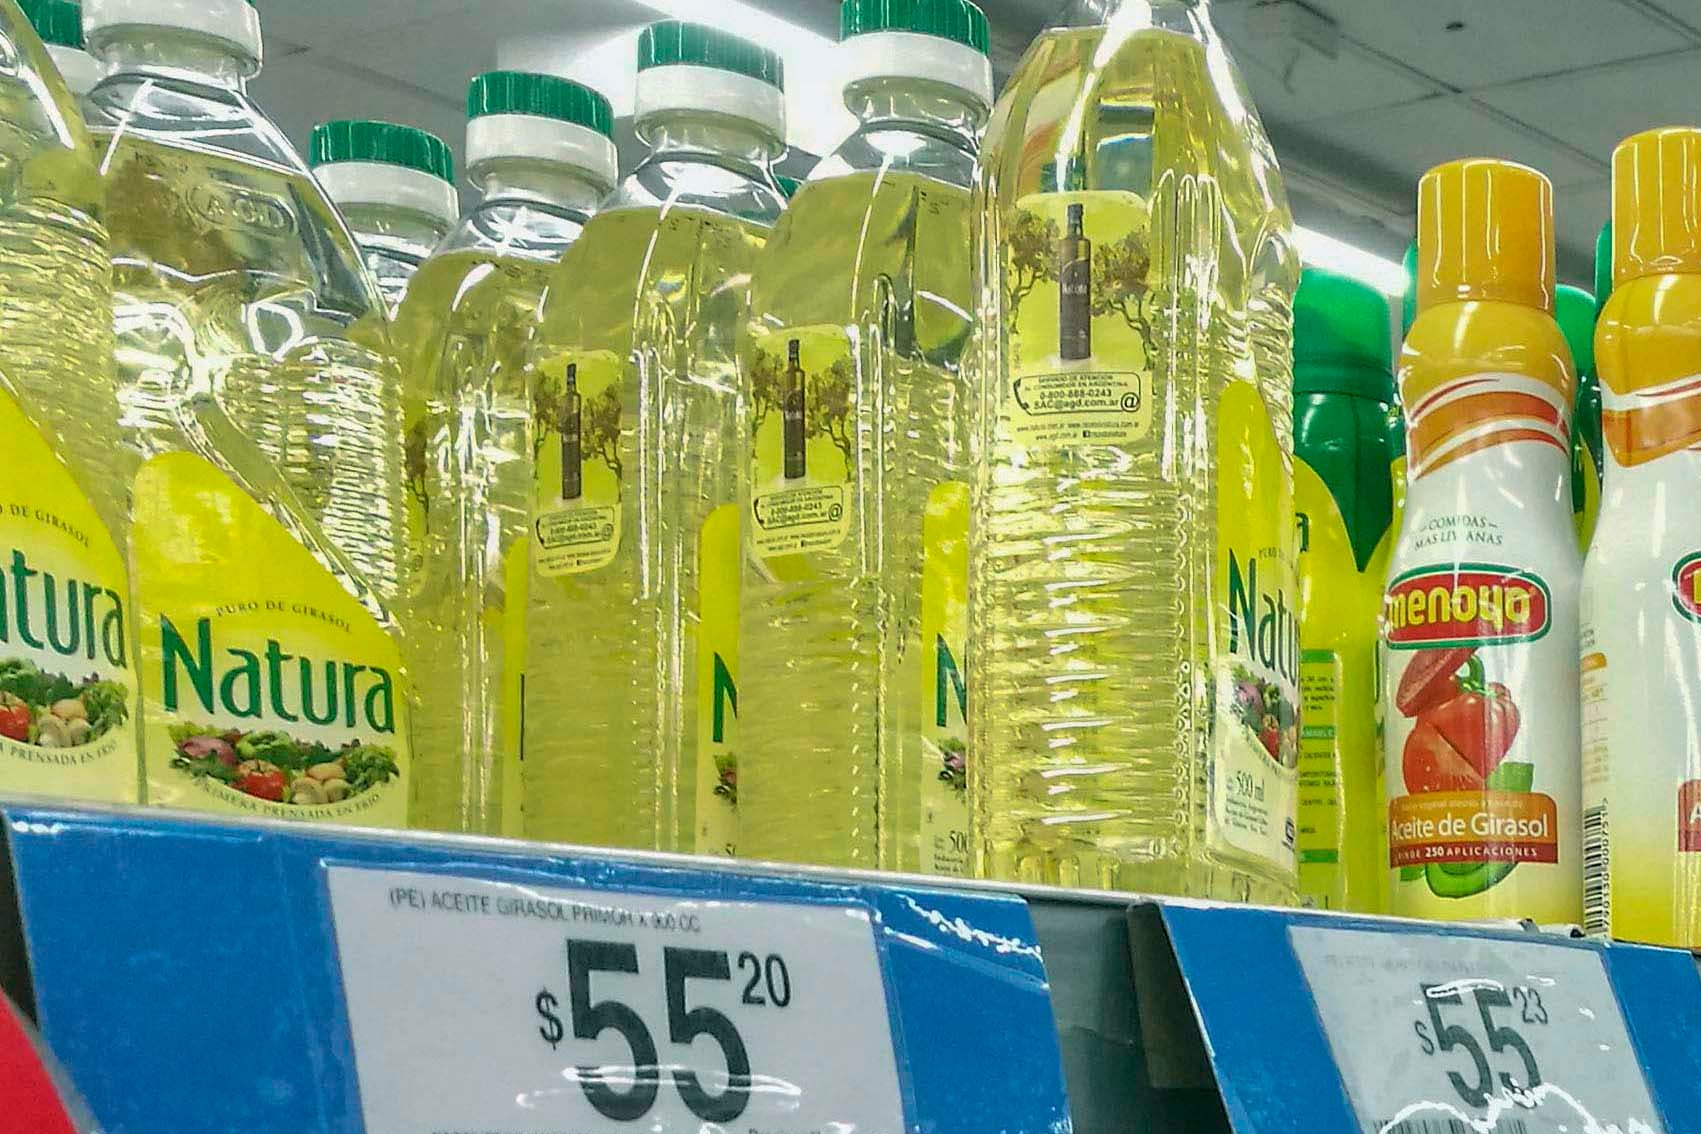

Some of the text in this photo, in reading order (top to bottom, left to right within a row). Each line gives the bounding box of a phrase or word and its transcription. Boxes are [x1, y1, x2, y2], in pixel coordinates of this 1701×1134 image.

[0, 548, 127, 669] tura
[264, 600, 285, 612] DE
[1389, 585, 1531, 632] menoyo
[160, 613, 396, 734] Natura
[1392, 811, 1549, 840] Aceite de Girasol
[1425, 846, 1445, 858] 250
[1446, 845, 1538, 858] APLICACIONES
[388, 887, 426, 910] (PE)
[432, 889, 491, 914] ACEITE
[496, 897, 569, 921] GIRASOL
